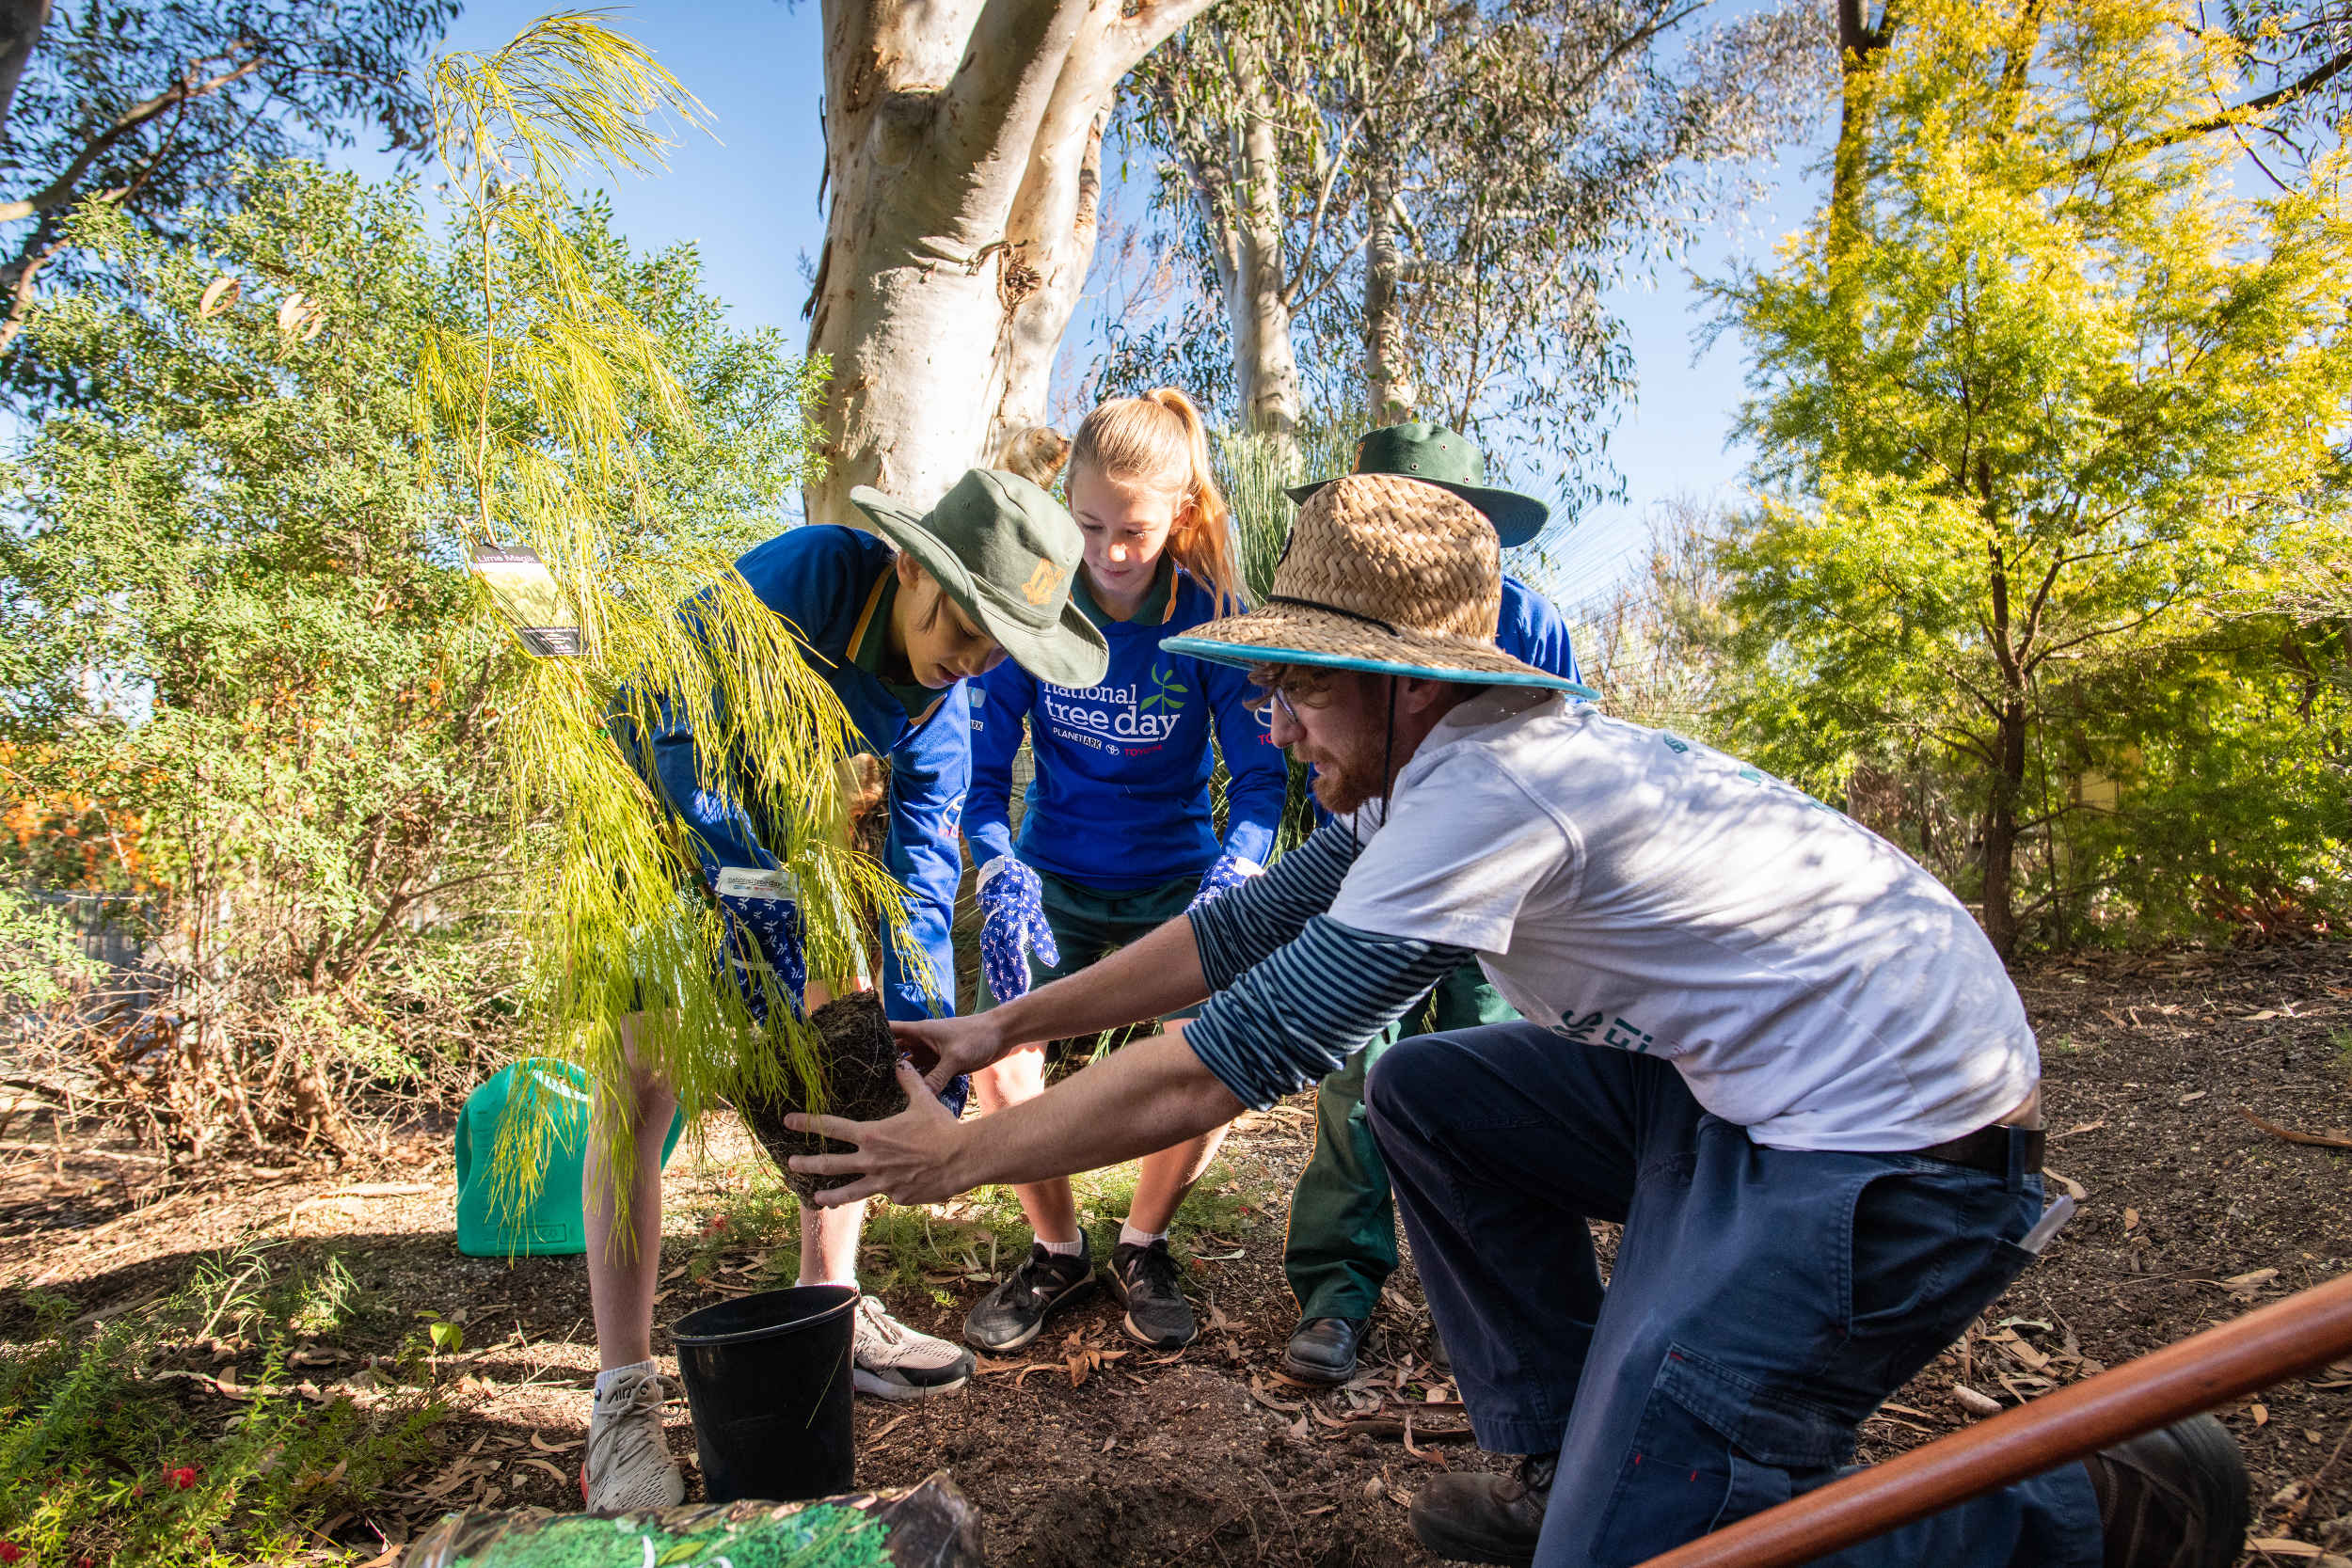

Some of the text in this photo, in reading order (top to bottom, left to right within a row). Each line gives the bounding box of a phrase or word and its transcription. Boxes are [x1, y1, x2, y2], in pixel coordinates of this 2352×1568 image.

[1044, 695, 1181, 740] tree day
[1124, 744, 1163, 757] TOY
